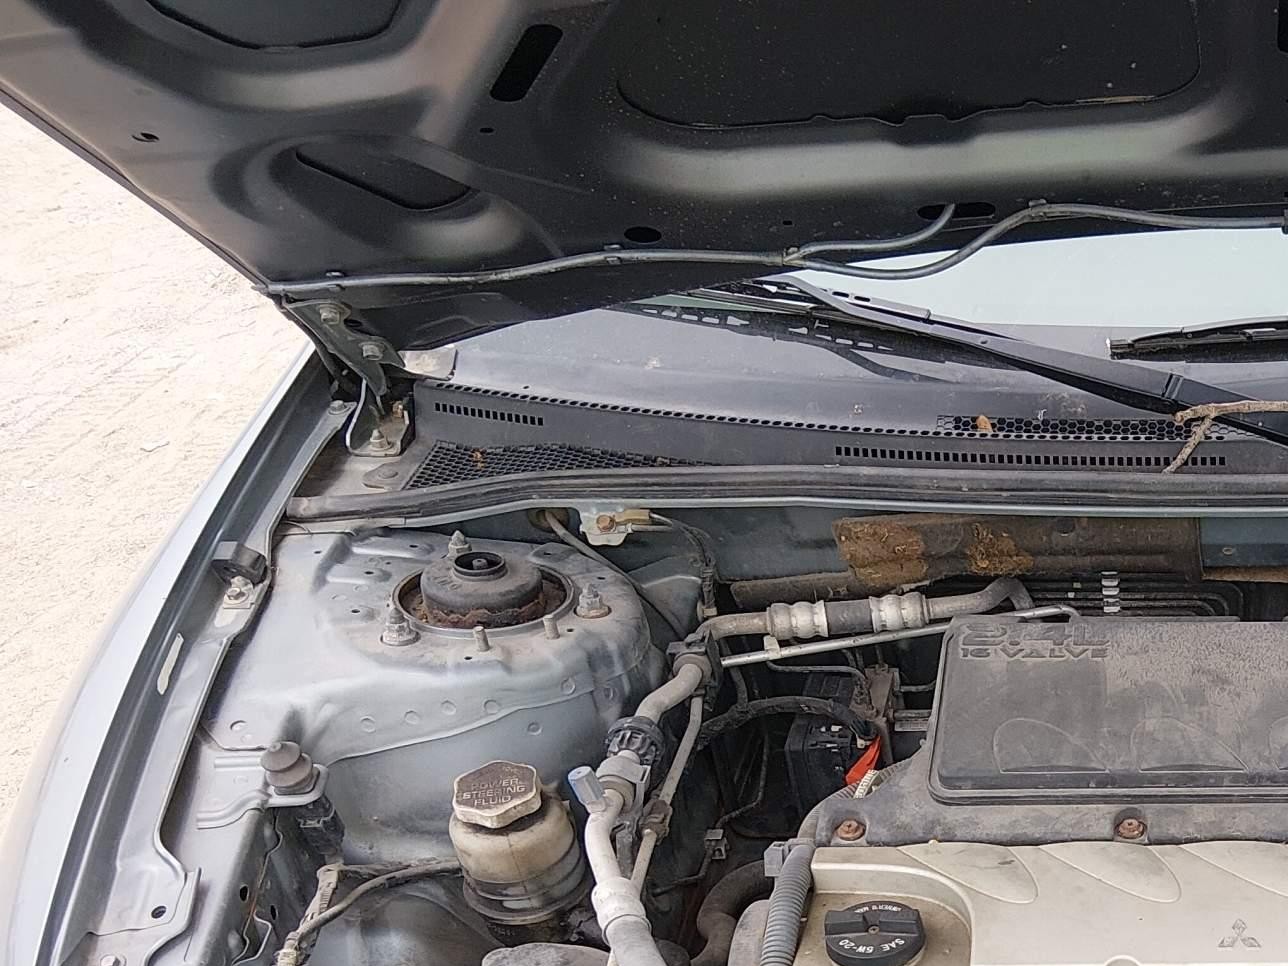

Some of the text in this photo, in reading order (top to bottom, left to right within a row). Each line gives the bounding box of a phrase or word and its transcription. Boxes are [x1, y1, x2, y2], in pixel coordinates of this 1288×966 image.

[961, 623, 1110, 646] 2.4L
[961, 647, 1109, 659] 16 VALVE
[472, 778, 519, 791] POWER
[463, 785, 526, 800] STEERING
[474, 795, 512, 806] FLUID
[838, 938, 905, 953] SAE 5W-20
